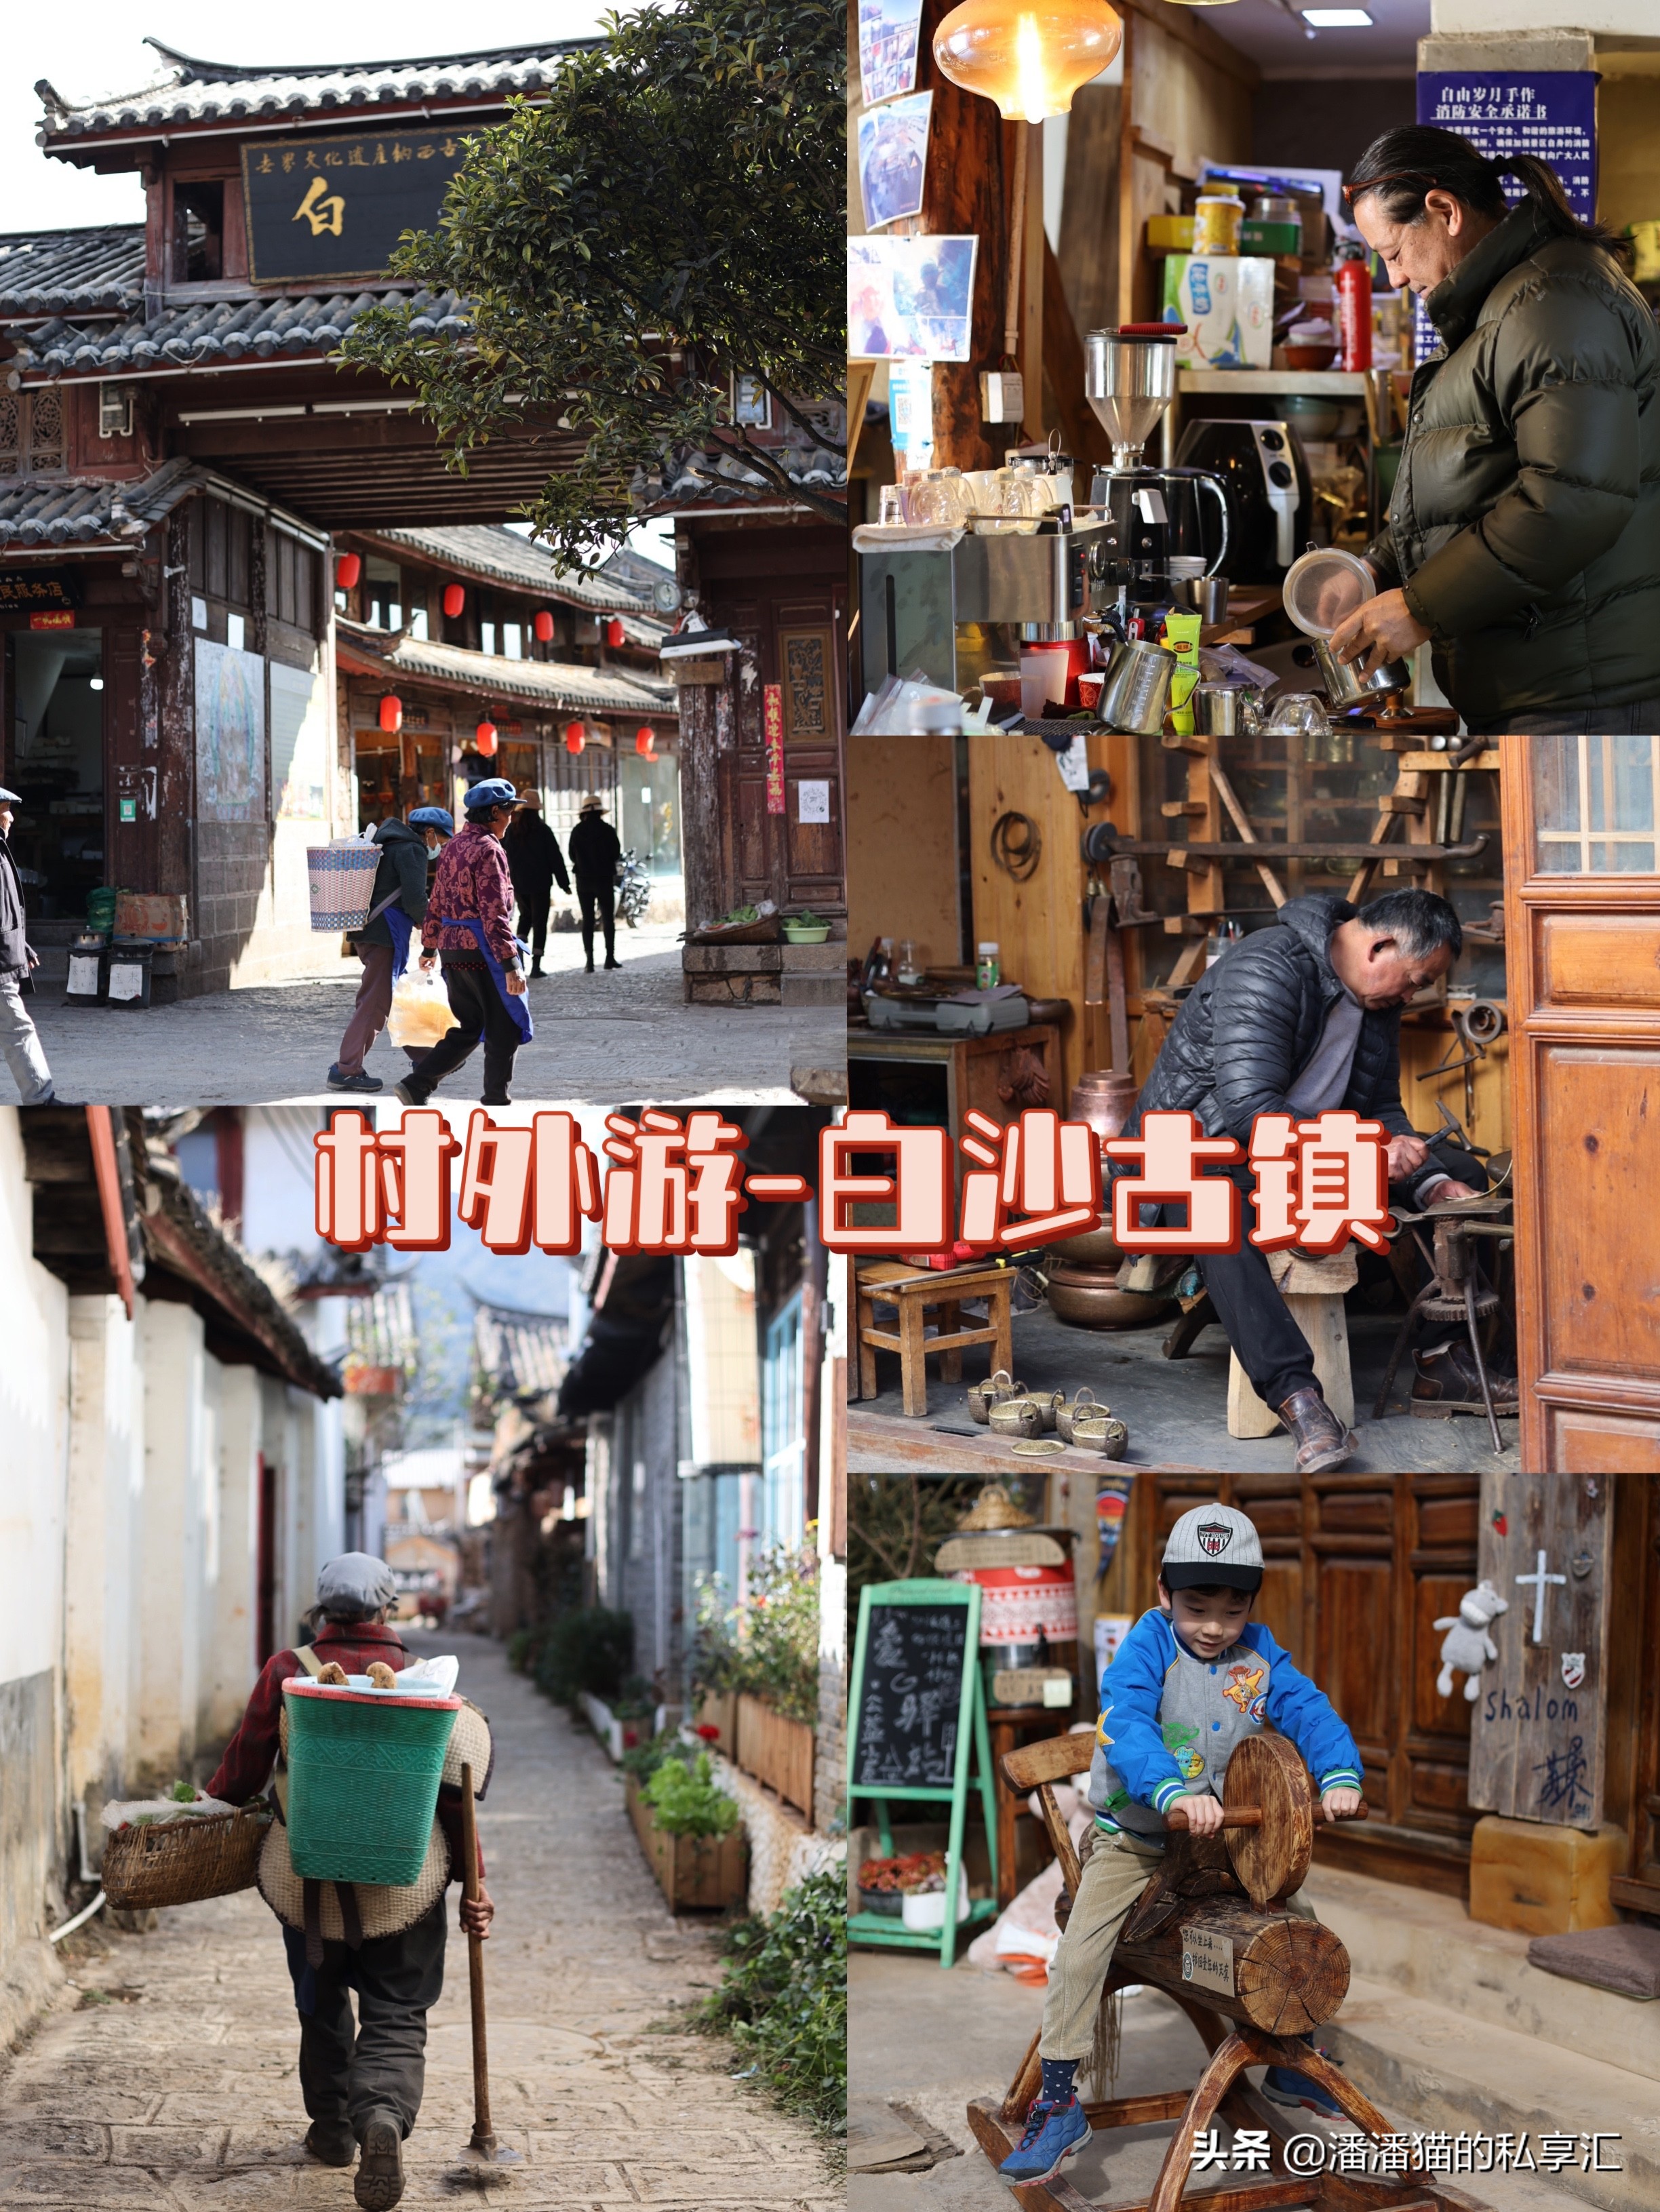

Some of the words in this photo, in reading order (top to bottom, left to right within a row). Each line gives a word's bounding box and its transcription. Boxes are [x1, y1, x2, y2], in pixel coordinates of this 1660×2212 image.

[1442, 87, 1535, 102] 自由岁月手作
[1436, 104, 1547, 119] 消防安全承诺书
[292, 176, 346, 237] 白
